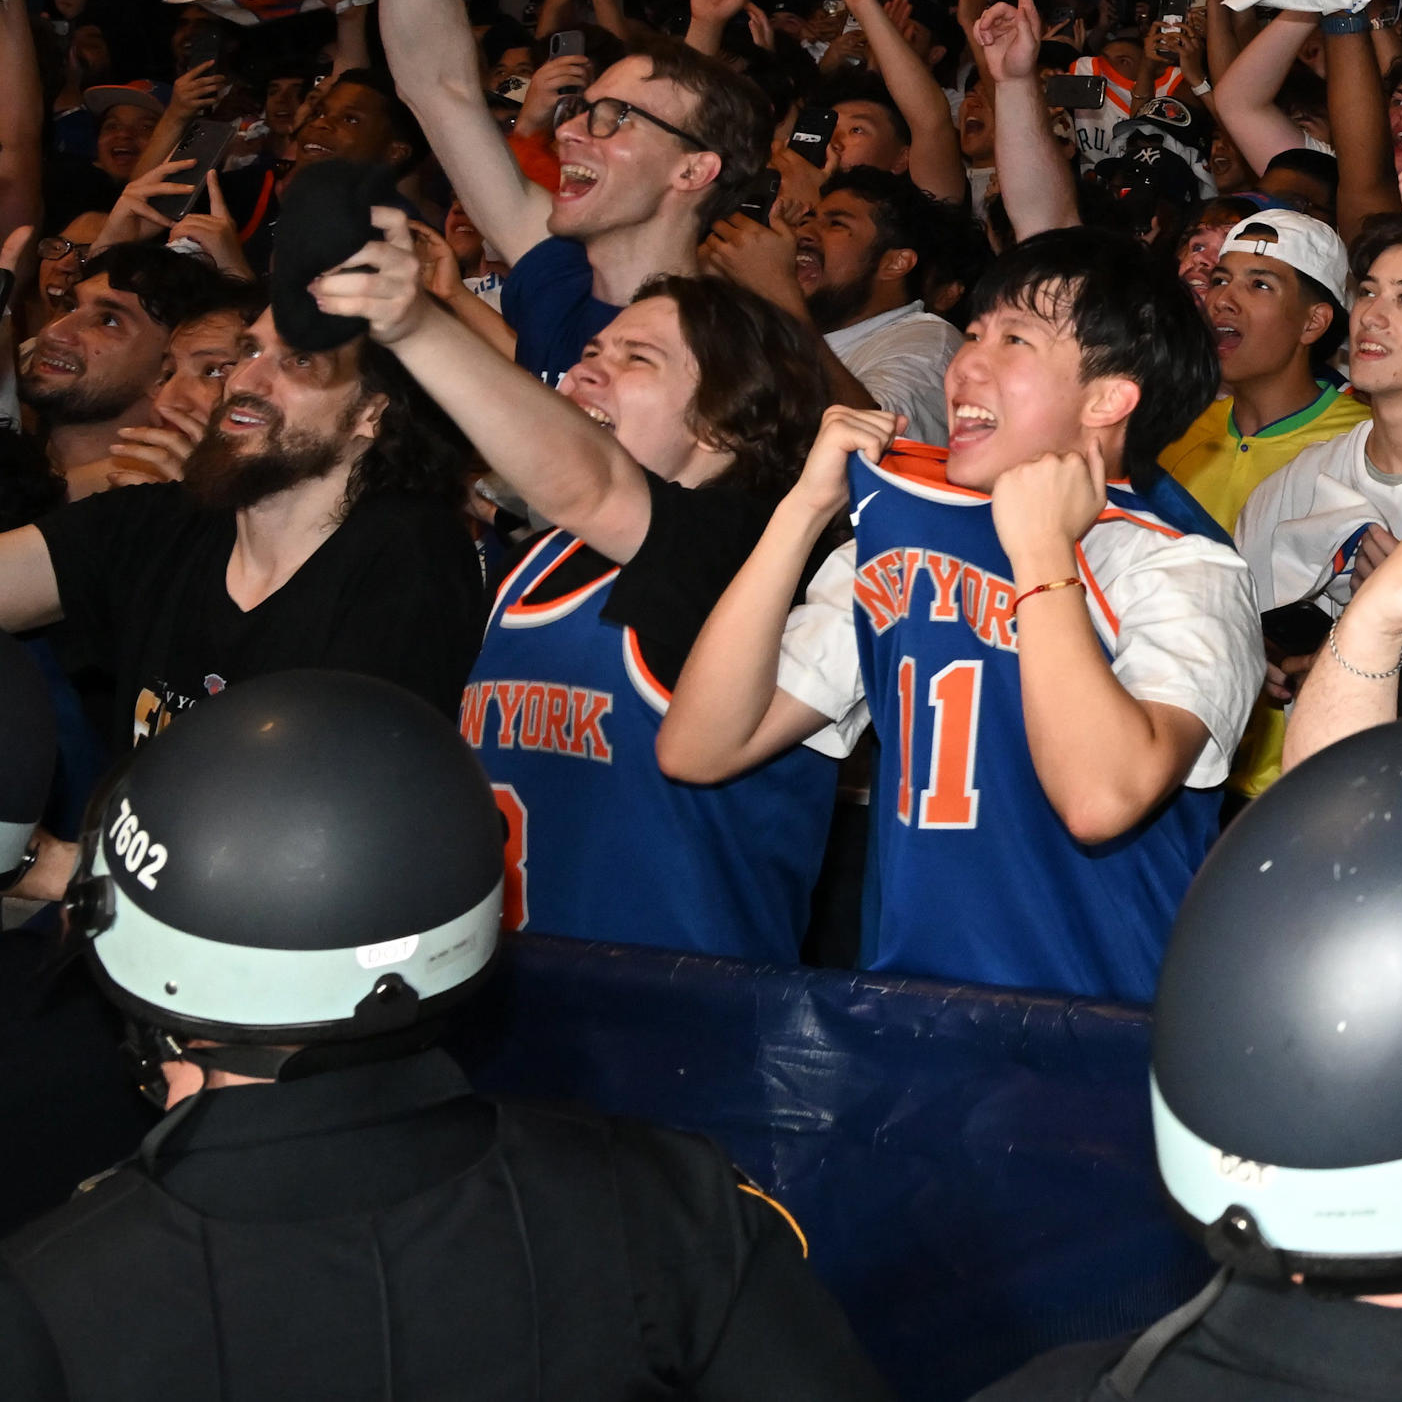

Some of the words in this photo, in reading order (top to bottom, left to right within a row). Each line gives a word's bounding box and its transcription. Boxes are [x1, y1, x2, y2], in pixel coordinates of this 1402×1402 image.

[926, 548, 1019, 654] YOR
[496, 680, 613, 765] YORK
[897, 655, 984, 830] 11
[108, 798, 168, 891] 7602
